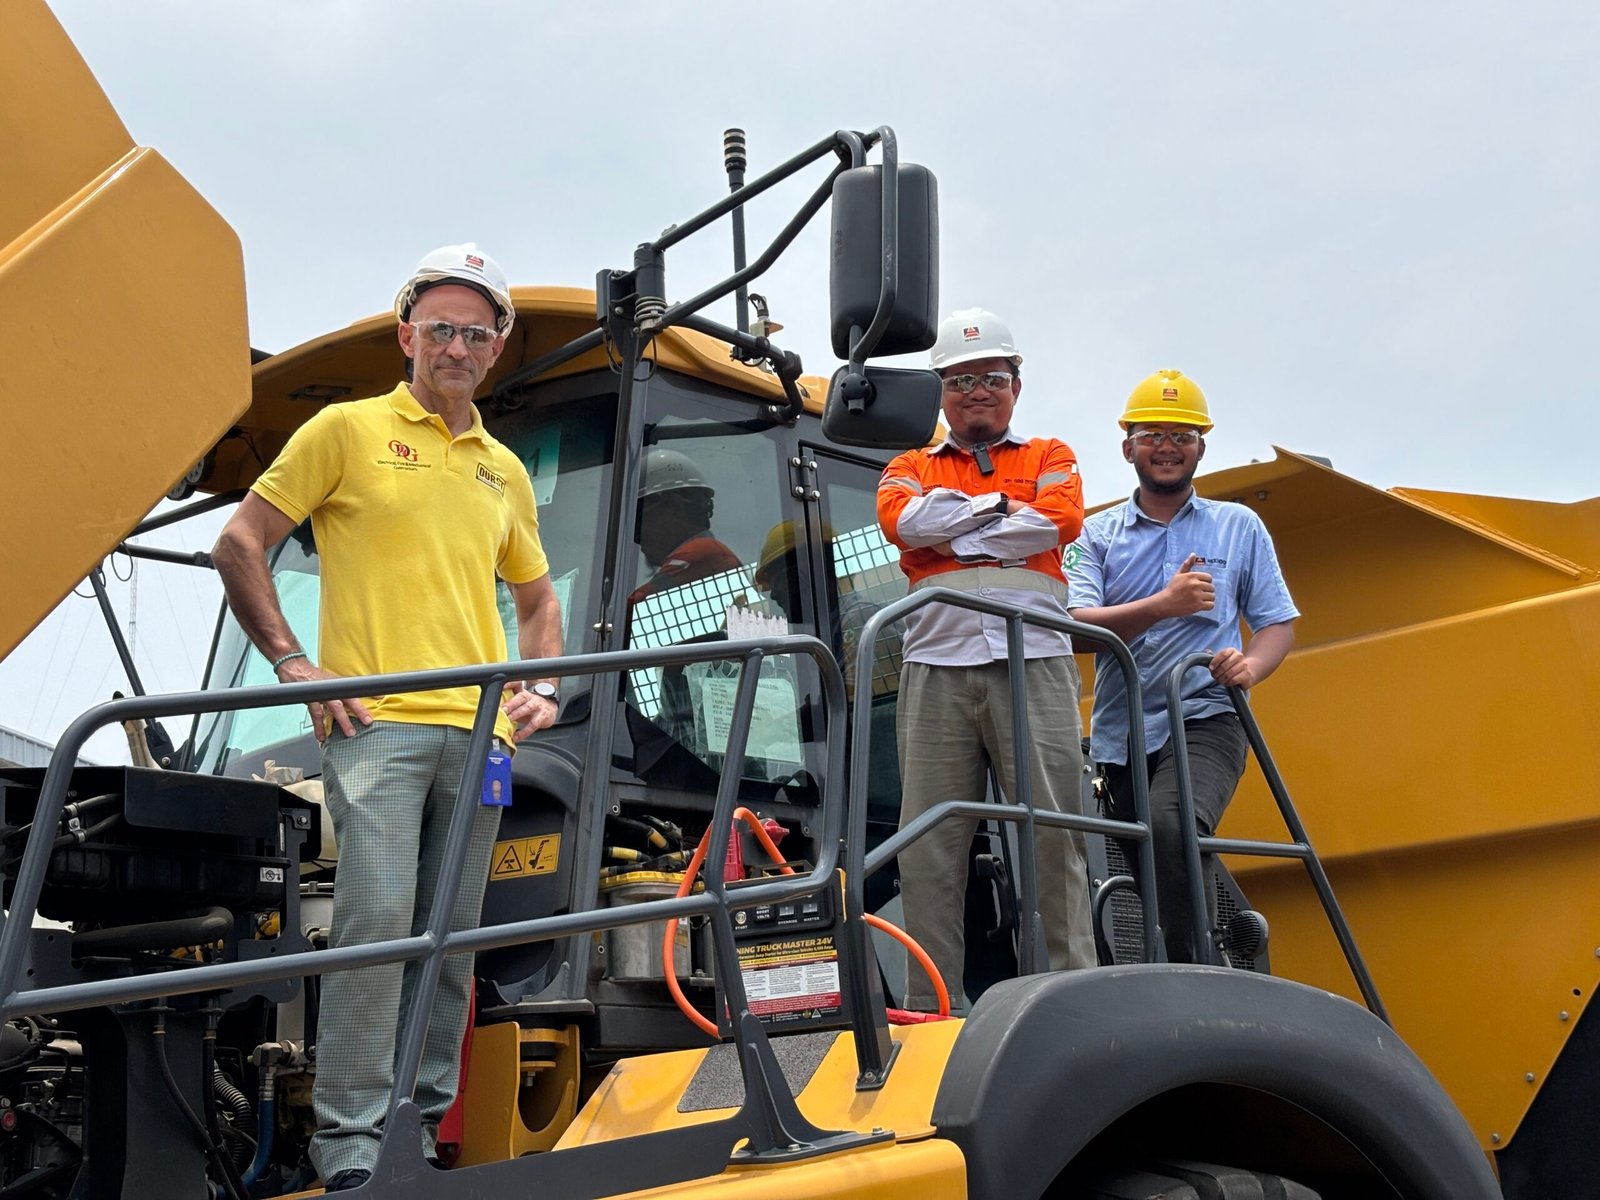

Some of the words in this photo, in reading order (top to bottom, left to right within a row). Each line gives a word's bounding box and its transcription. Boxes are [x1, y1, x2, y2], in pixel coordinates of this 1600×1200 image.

[479, 466, 504, 490] DURST
[755, 943, 782, 952] TRUCK
[782, 939, 816, 949] MASTER
[816, 937, 833, 945] 24V
